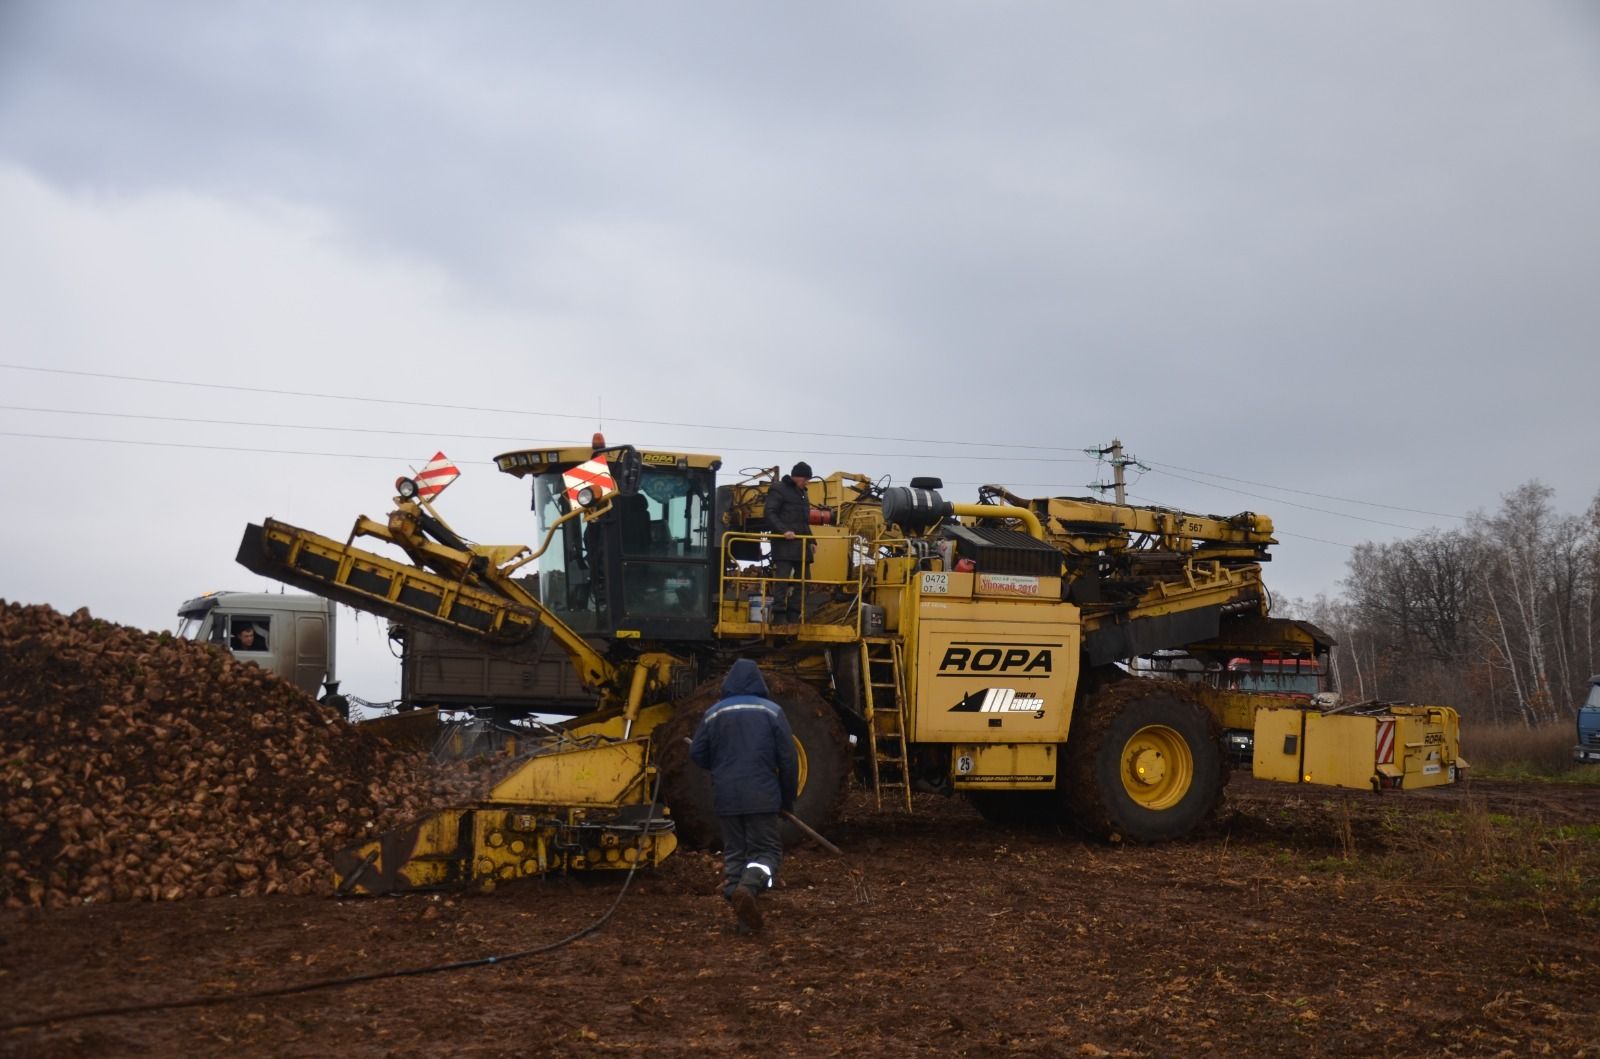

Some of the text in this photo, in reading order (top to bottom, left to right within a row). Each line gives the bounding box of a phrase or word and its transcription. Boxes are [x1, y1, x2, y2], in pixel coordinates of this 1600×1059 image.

[1189, 523, 1203, 532] 567
[925, 574, 946, 583] 0472
[938, 648, 1052, 672] ROPA
[1033, 710, 1045, 719] 3
[960, 758, 970, 771] 25
